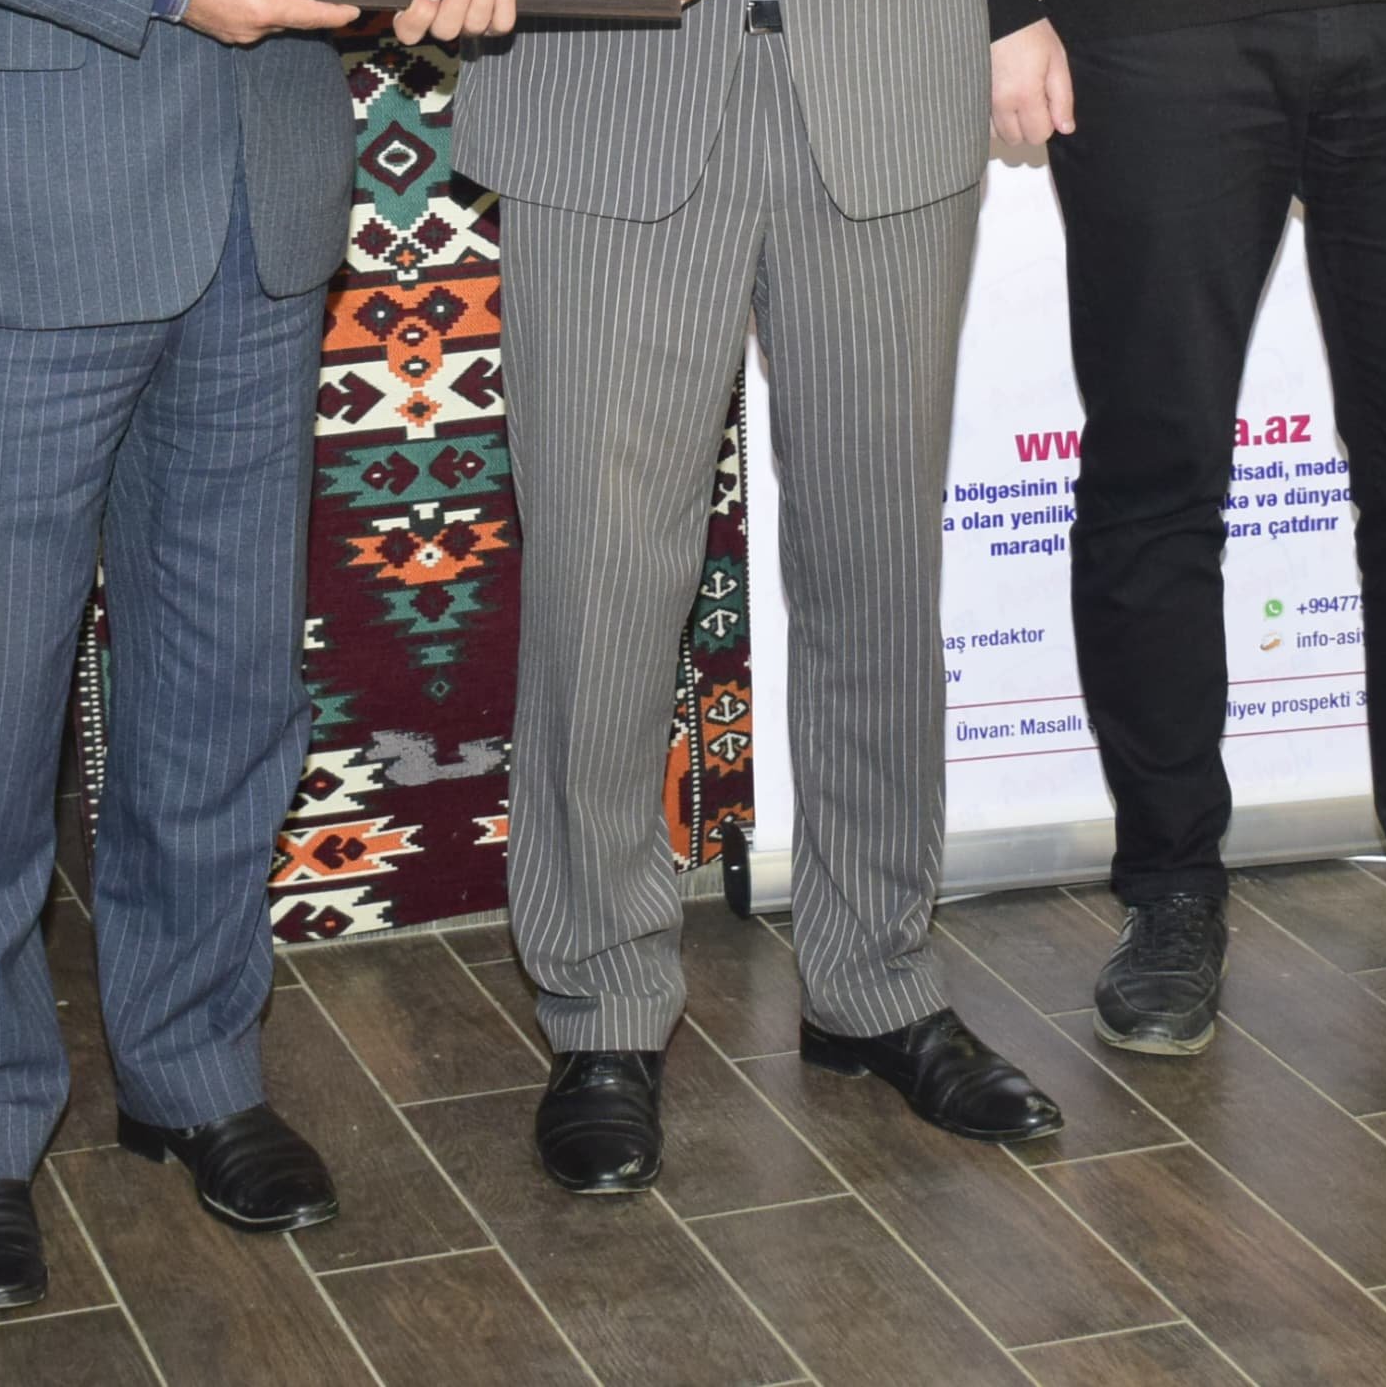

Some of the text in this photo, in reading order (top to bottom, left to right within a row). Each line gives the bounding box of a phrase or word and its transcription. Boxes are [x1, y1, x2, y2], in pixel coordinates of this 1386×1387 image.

[955, 478, 1057, 504] bölgəsinin
[1230, 460, 1289, 481] tisadi,
[1295, 457, 1348, 477] mədə
[962, 512, 1004, 530] olan
[1011, 504, 1077, 530] yenilik
[1256, 492, 1277, 508] və
[990, 515, 1338, 556] maraqlı lara çatdırır
[1296, 594, 1363, 615] +99477
[971, 628, 1045, 648] redaktor
[1297, 627, 1365, 648] info-asi
[956, 721, 1015, 741] Ünvan:
[1020, 715, 1082, 735] Masallı
[1226, 699, 1266, 720] liyev
[1272, 692, 1350, 716] prospekti
